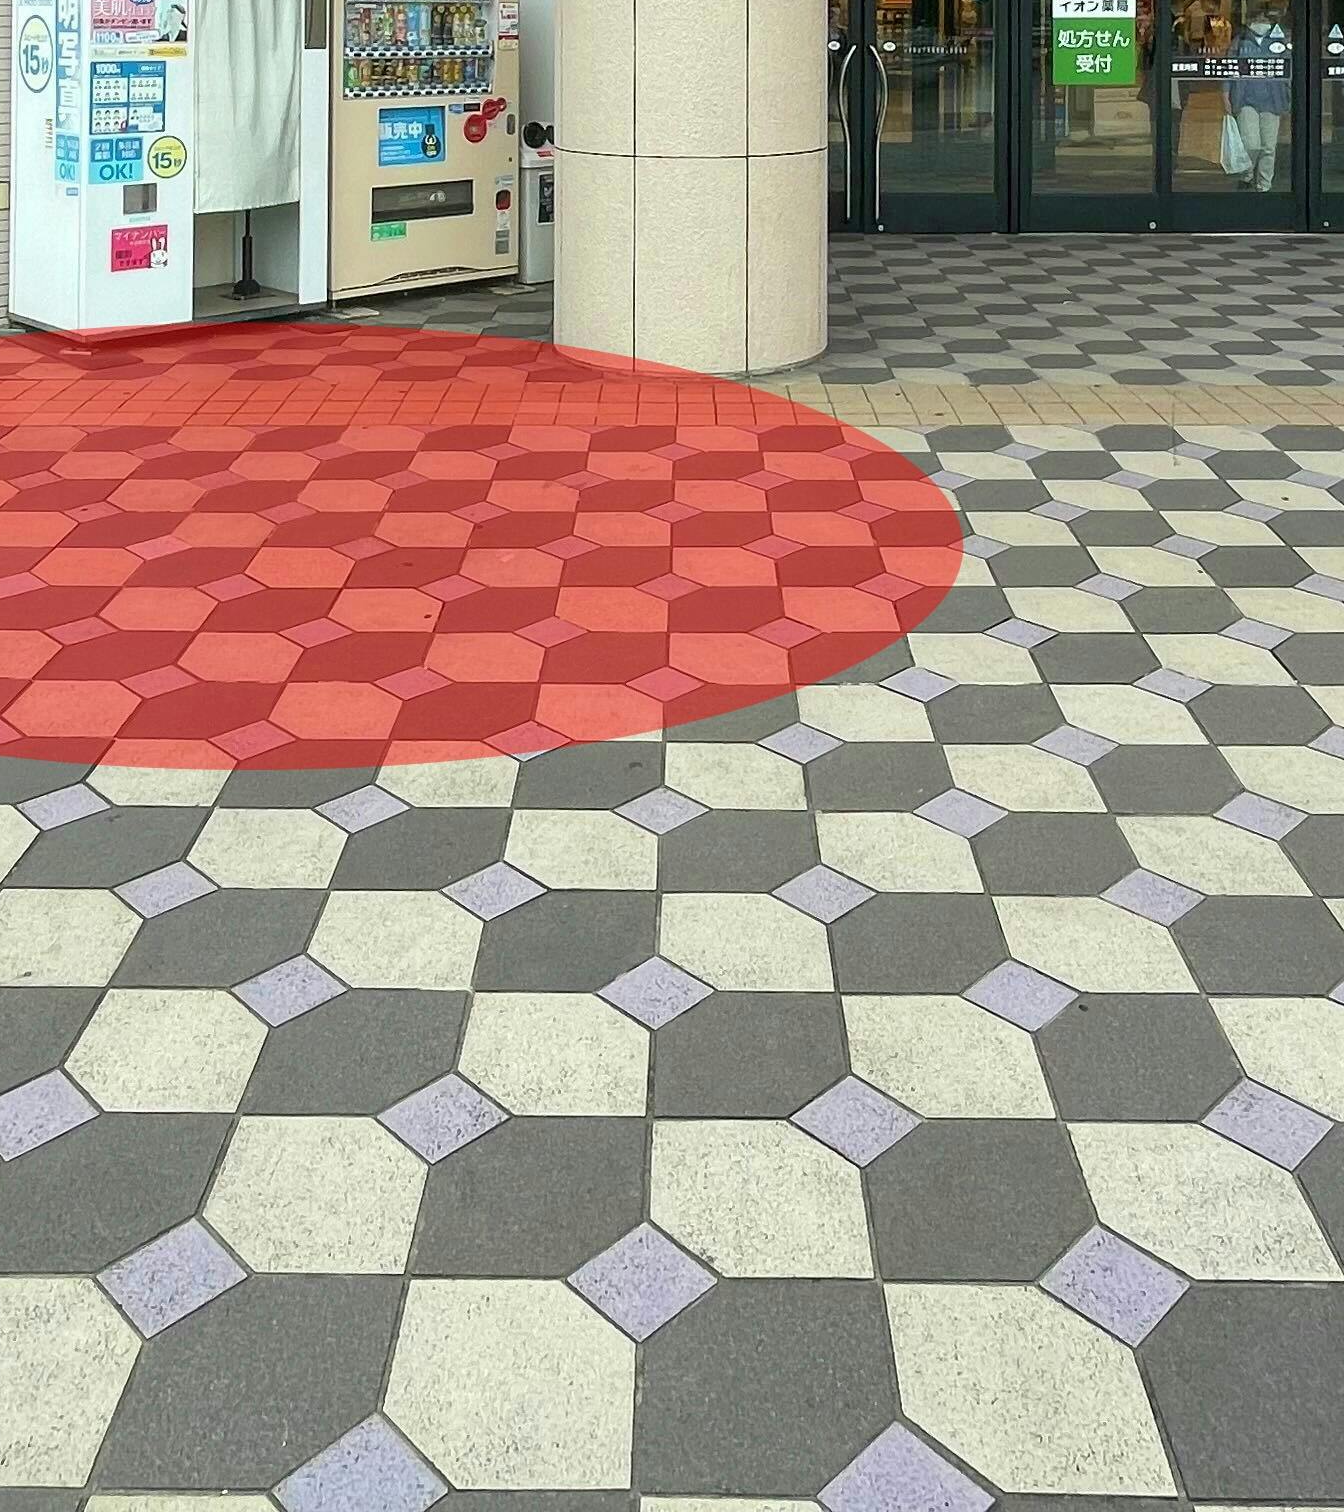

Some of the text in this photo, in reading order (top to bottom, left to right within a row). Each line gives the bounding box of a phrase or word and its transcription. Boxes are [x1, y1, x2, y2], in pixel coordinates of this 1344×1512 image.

[1059, 0, 1129, 13] イオン薬局
[1057, 29, 1130, 49] 処方せん
[1075, 53, 1113, 74] 受付
[99, 162, 133, 181] OK!
[114, 229, 166, 241] マイナンバー
